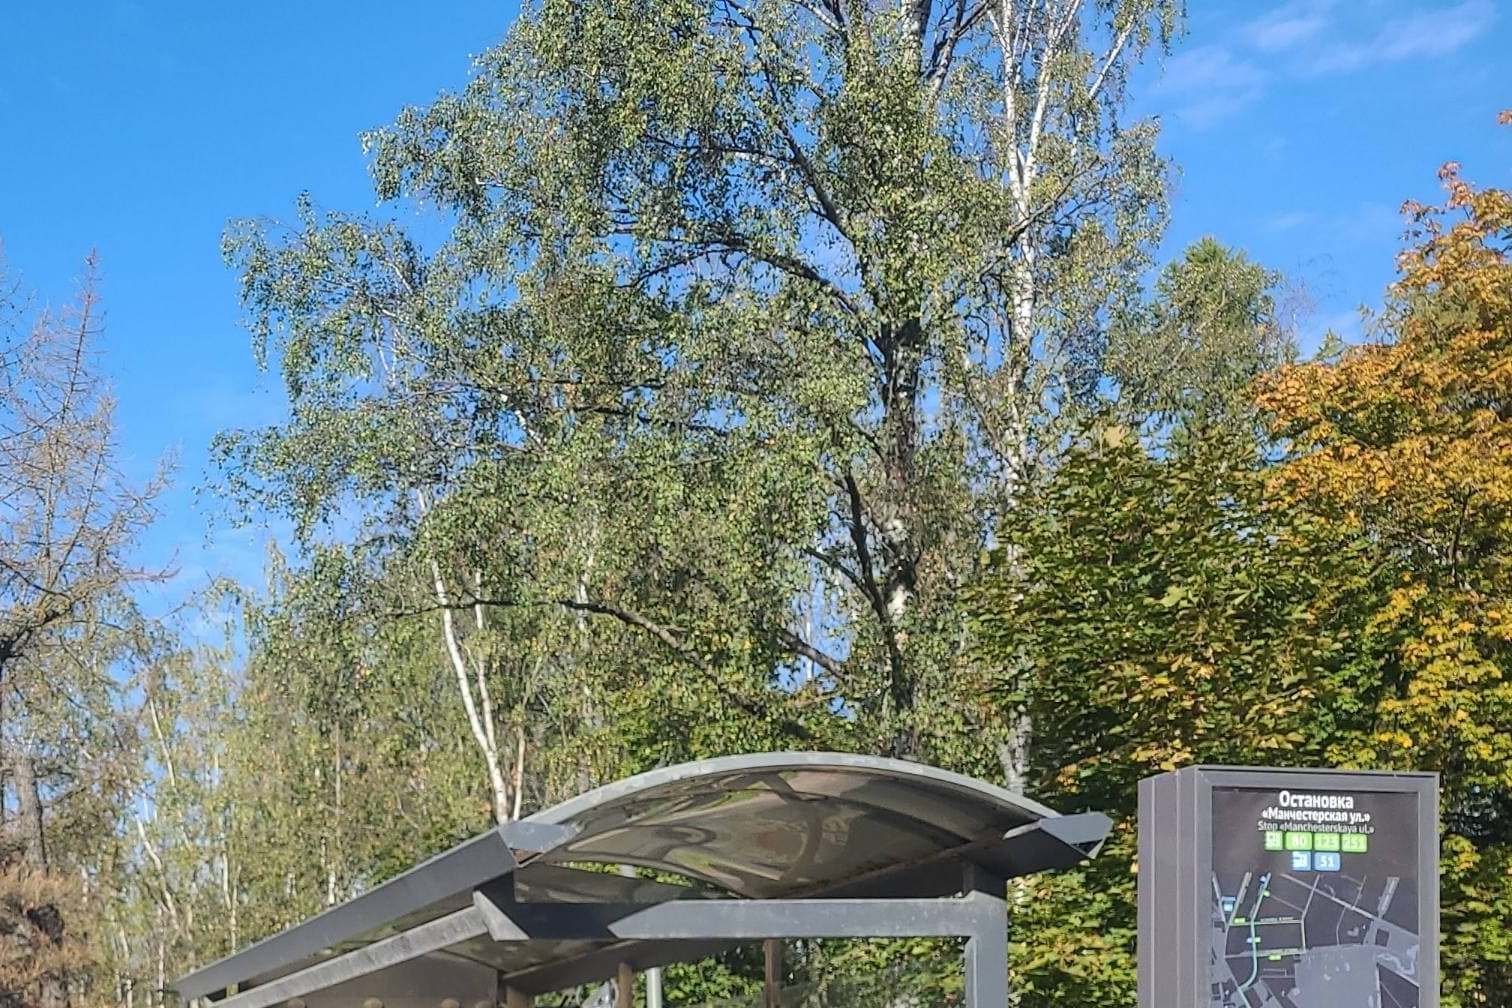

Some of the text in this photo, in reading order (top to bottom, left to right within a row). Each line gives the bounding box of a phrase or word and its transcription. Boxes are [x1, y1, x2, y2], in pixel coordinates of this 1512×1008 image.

[1279, 790, 1354, 809] Остановка
[1262, 806, 1370, 825] «Манчестерская ул.»
[1257, 820, 1278, 832] Stop
[1319, 855, 1335, 867] 51
